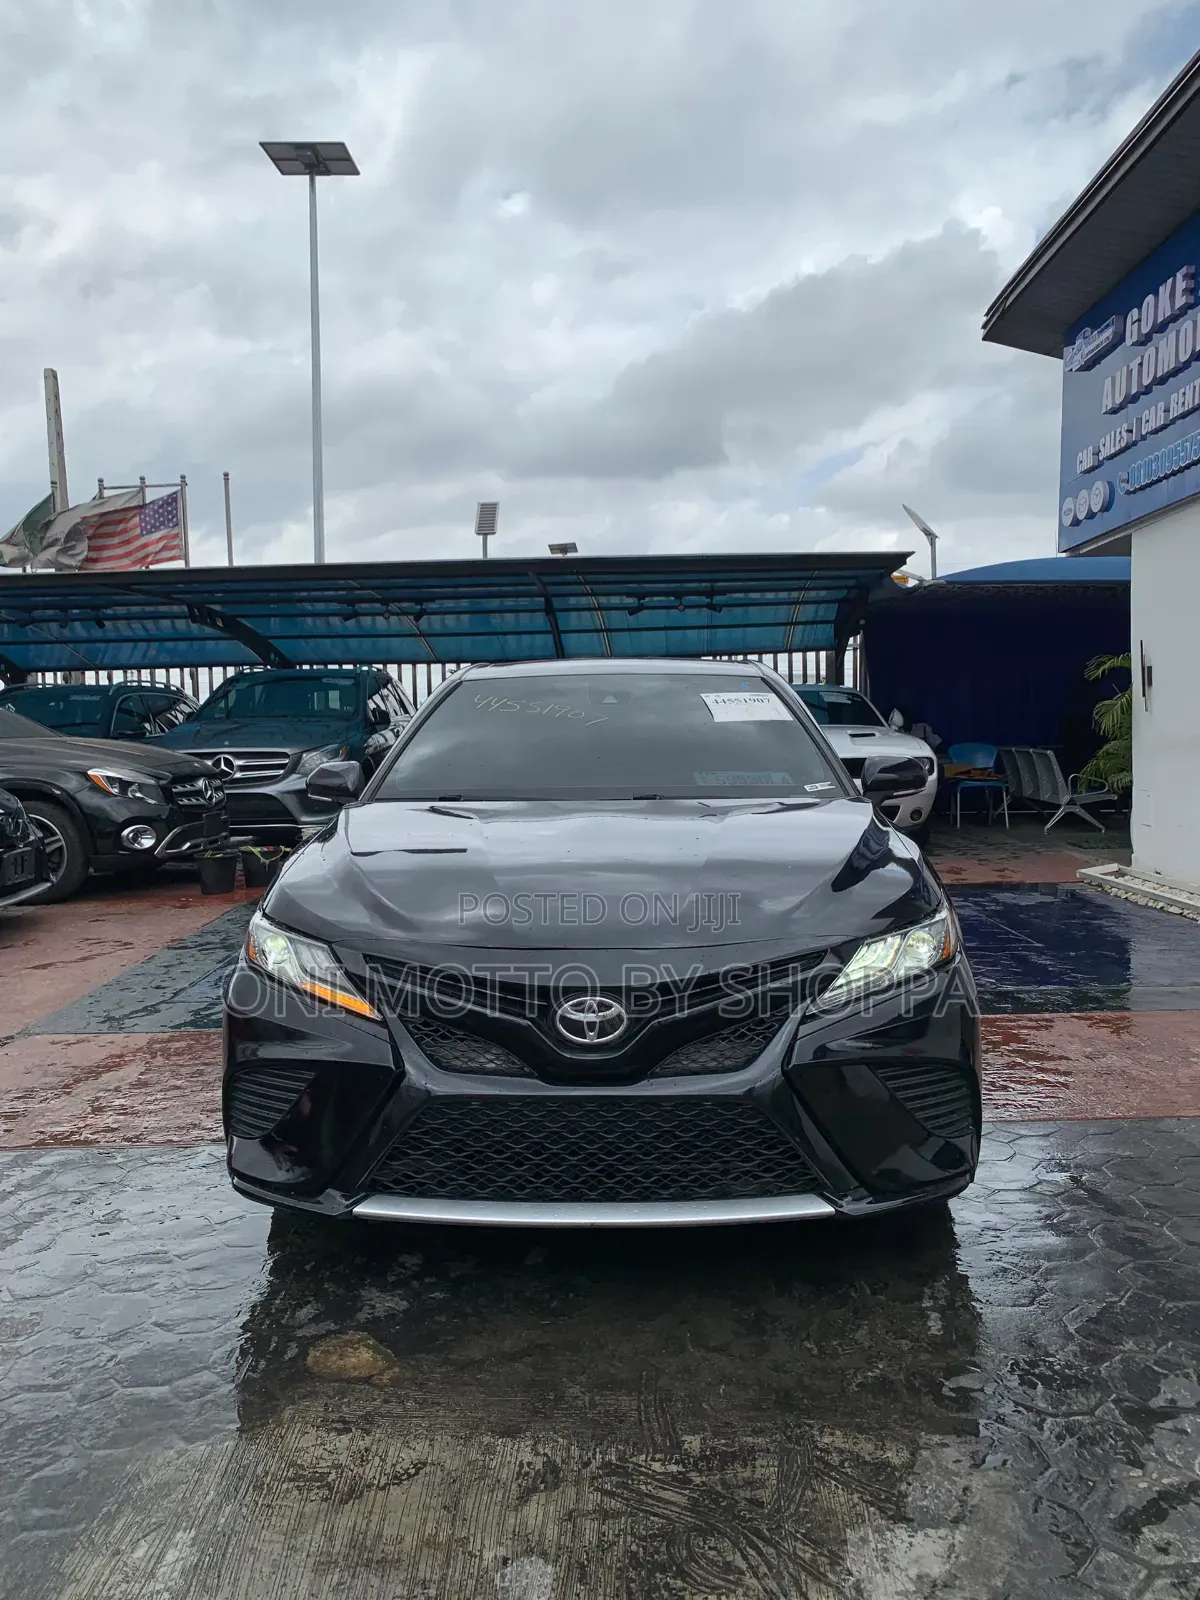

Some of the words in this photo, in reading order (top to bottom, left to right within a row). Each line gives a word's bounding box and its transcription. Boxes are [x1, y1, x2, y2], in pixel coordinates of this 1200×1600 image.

[1126, 265, 1190, 346] GOKE
[1102, 312, 1200, 414] AUTOMO
[1077, 445, 1094, 474] CAR
[1099, 423, 1128, 460] SALES
[1142, 401, 1164, 435] CAR
